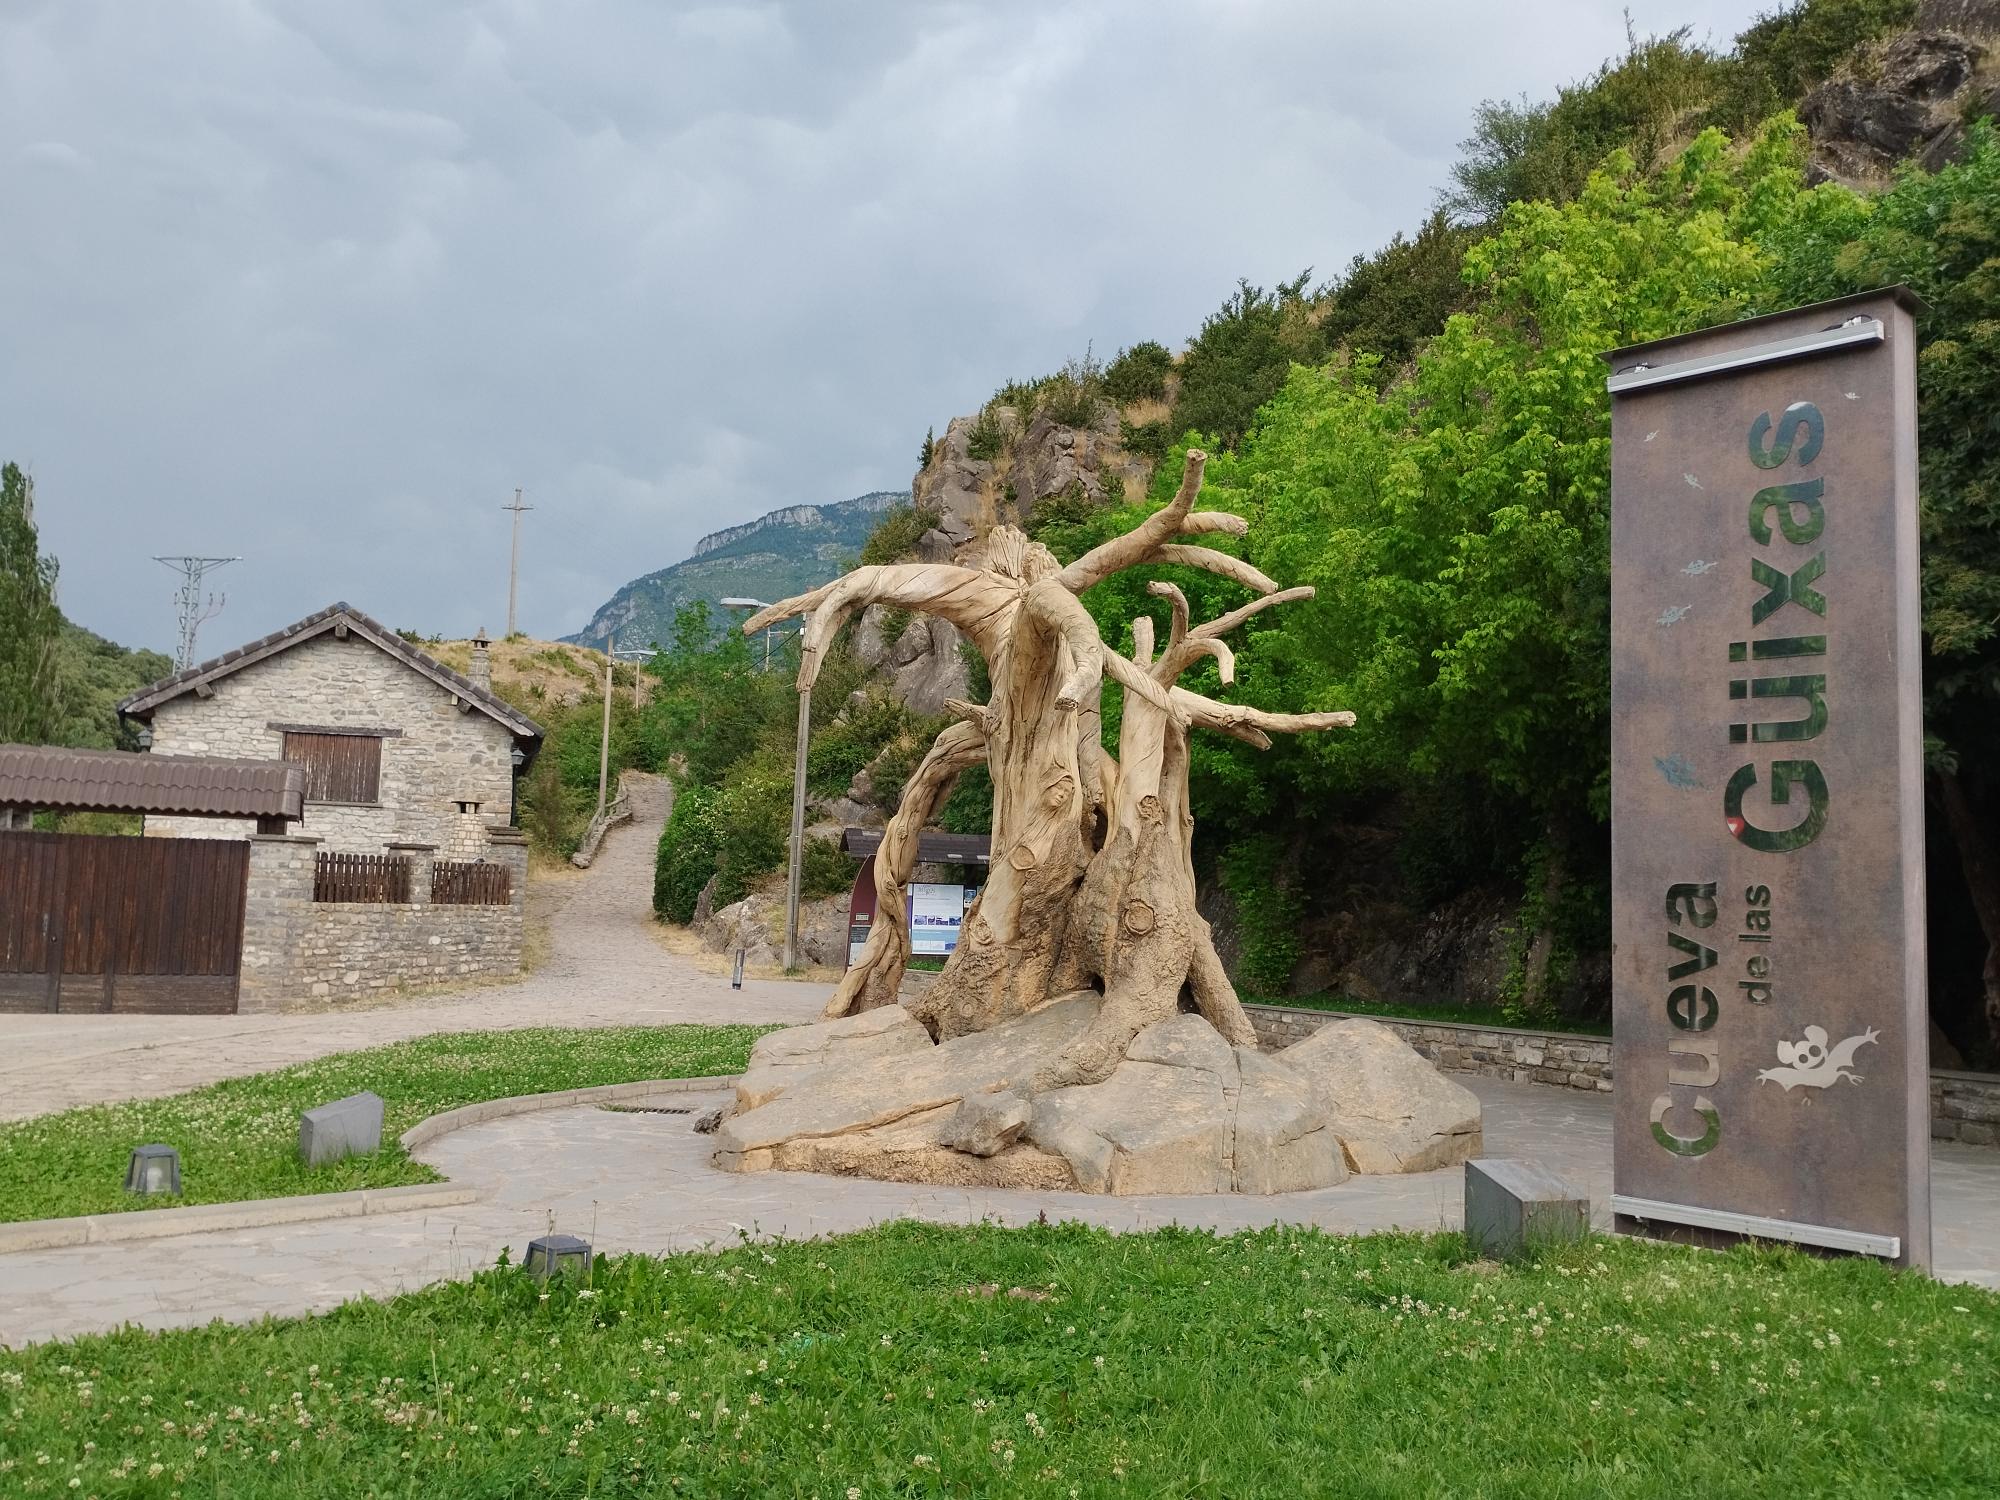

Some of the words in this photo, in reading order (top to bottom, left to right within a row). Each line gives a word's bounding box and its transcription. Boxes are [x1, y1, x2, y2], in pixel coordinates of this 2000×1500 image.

[1724, 401, 1829, 853] Güixas
[1738, 884, 1772, 942] las
[1738, 955, 1772, 1005] de
[1650, 881, 1721, 1158] Cueva
